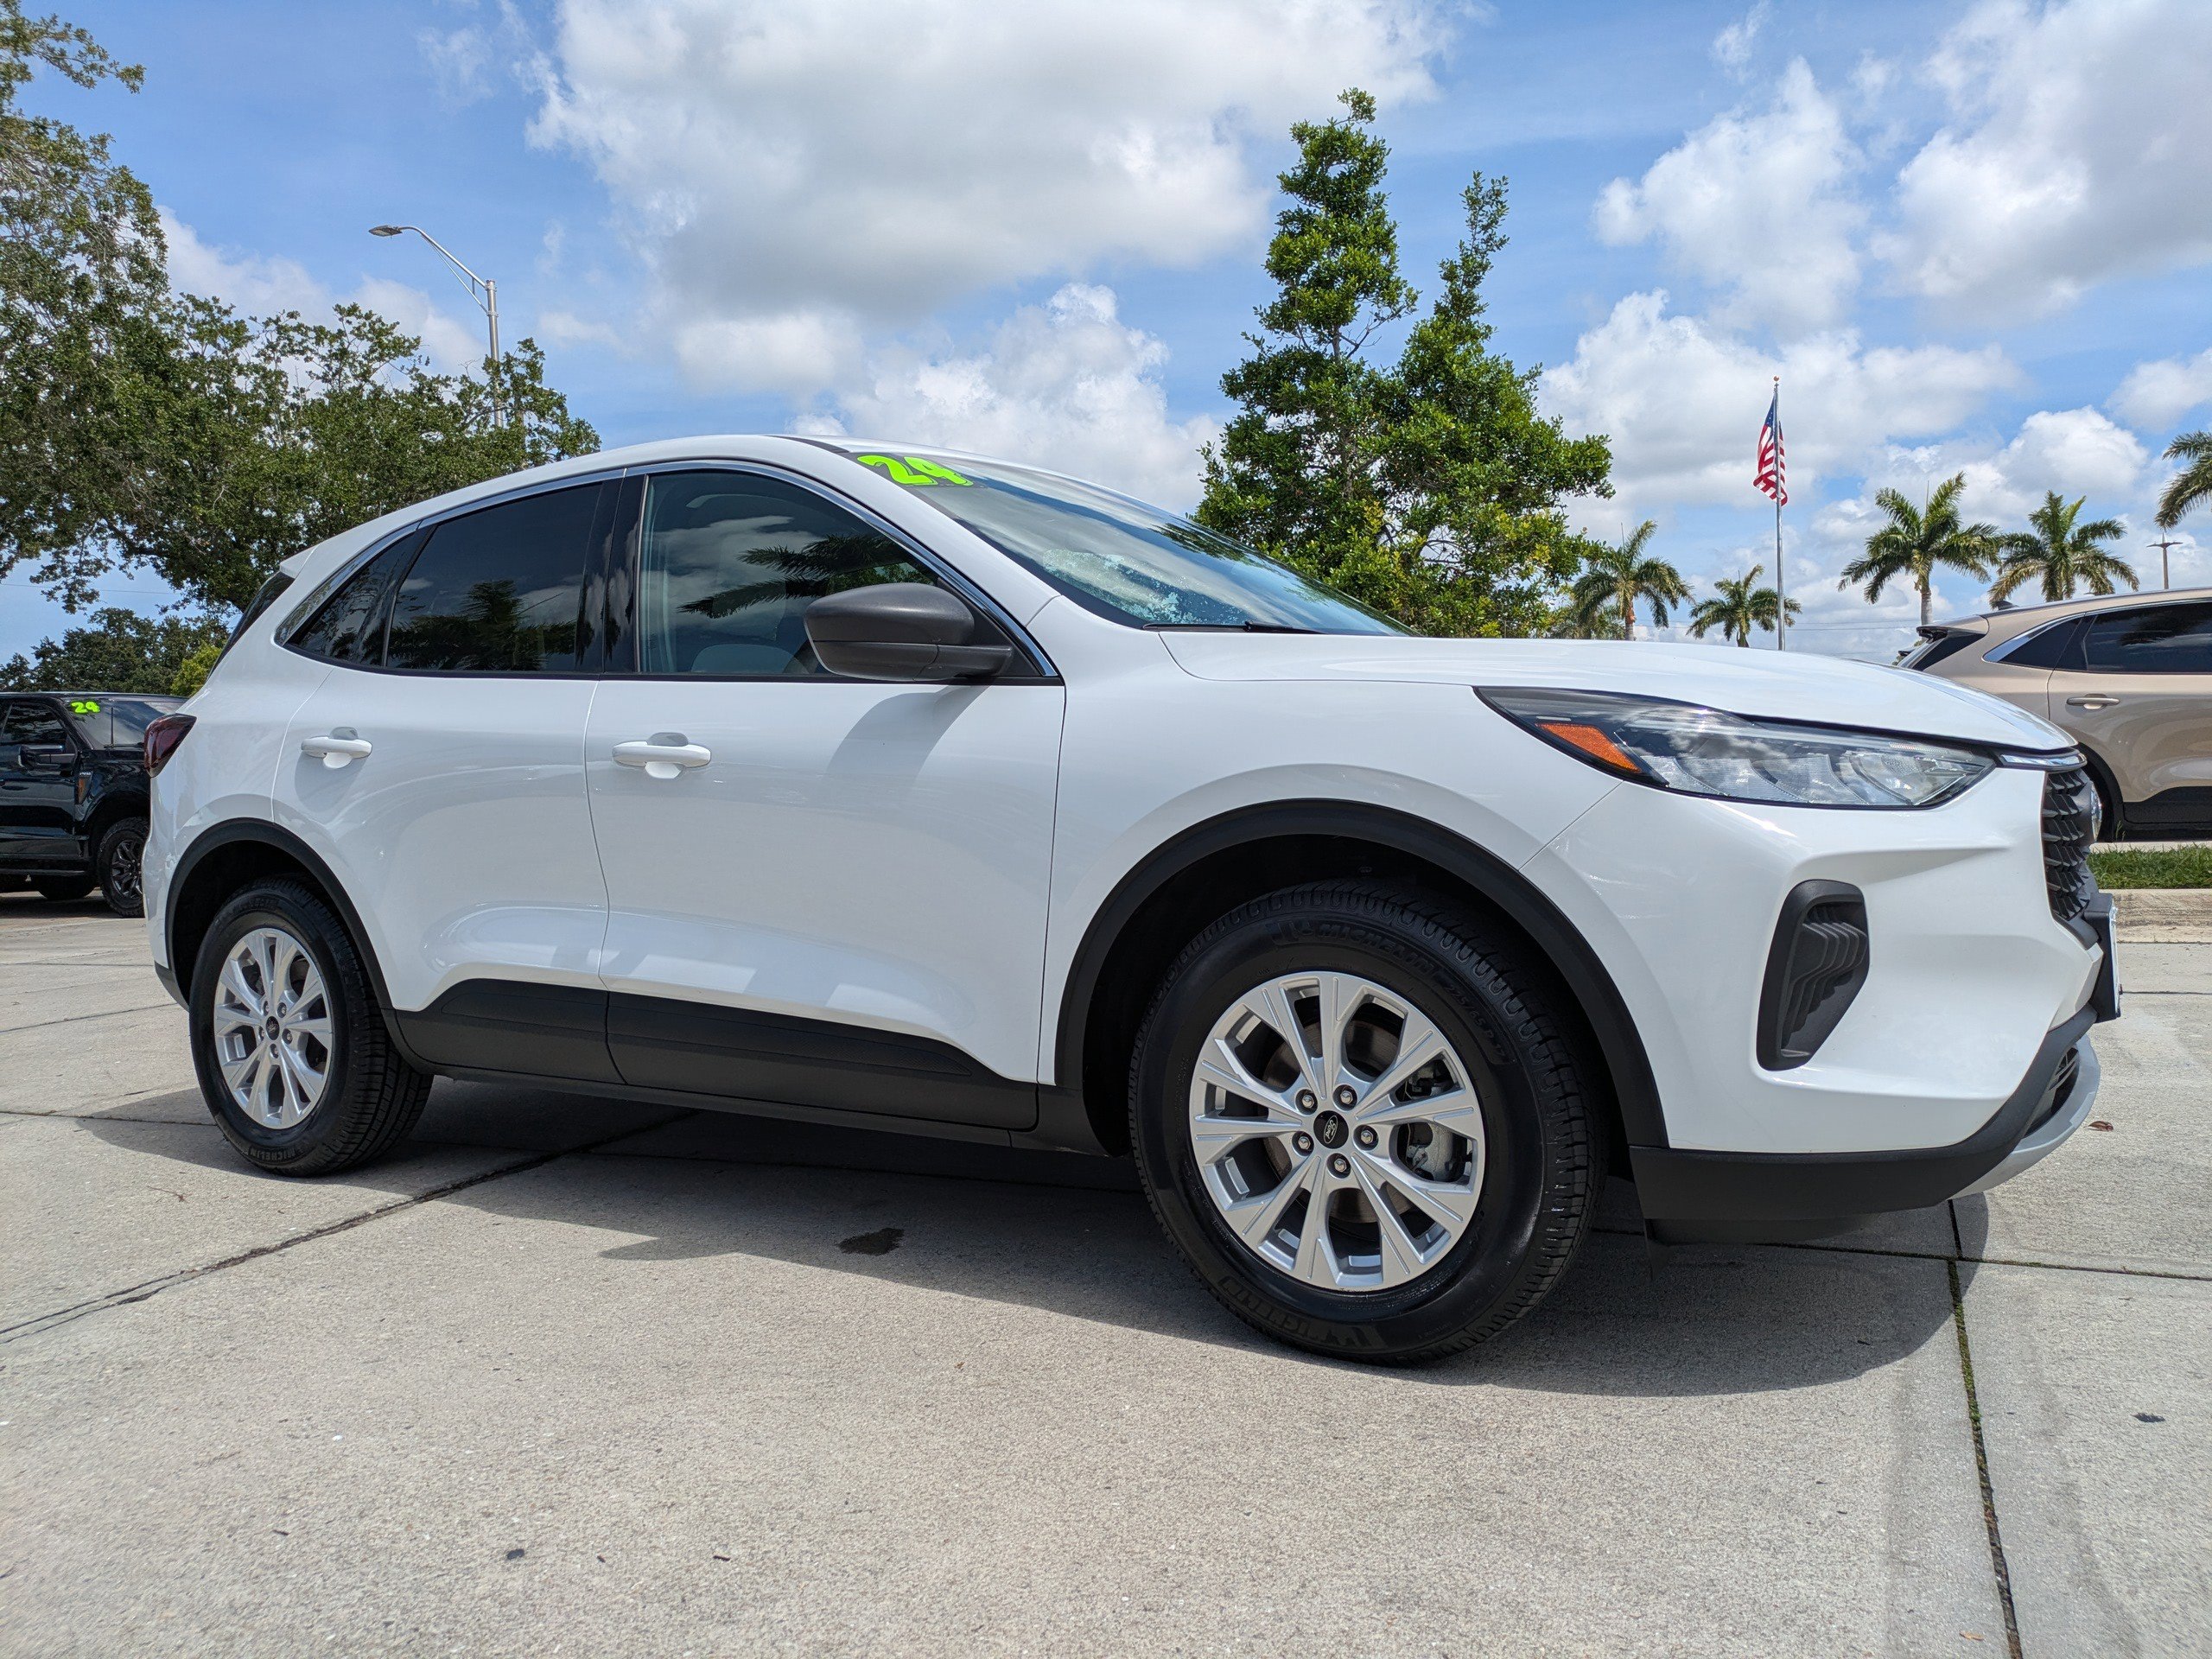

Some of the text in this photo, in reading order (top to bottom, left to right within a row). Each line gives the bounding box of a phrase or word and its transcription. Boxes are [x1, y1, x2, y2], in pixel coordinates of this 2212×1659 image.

[857, 454, 973, 486] 24
[1318, 923, 1437, 976] MICHELIN
[1325, 1118, 1337, 1141] Ford
